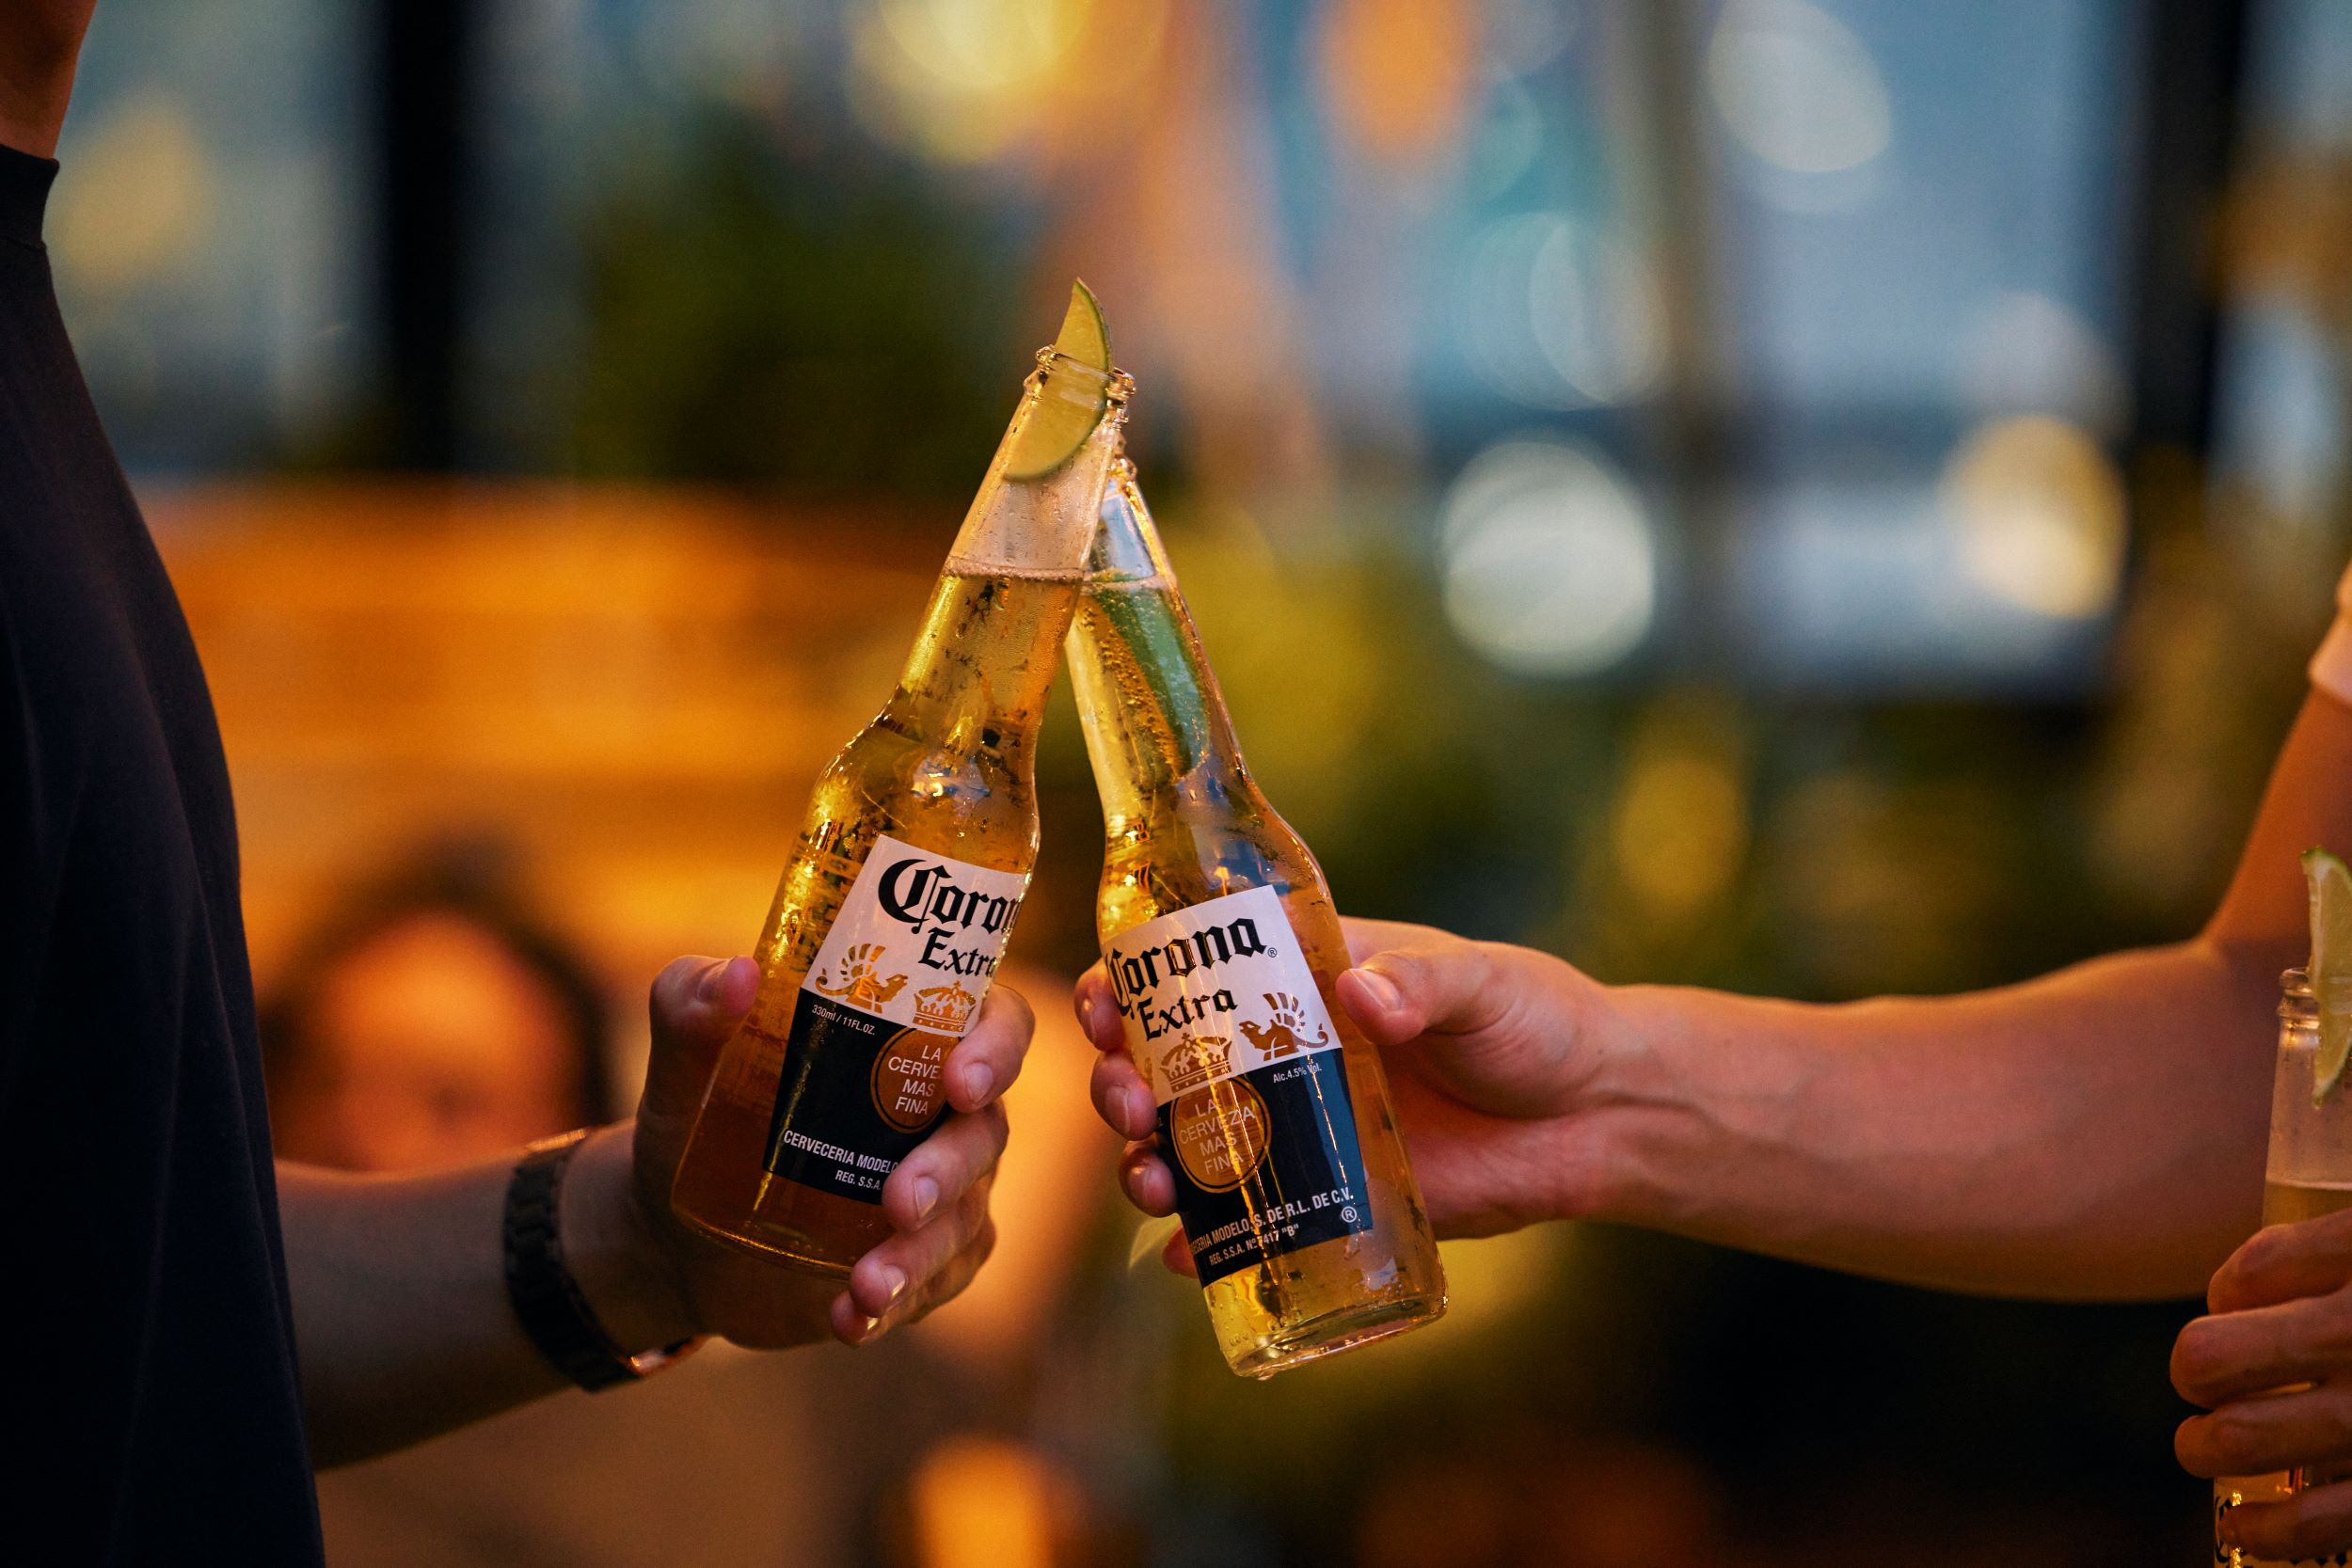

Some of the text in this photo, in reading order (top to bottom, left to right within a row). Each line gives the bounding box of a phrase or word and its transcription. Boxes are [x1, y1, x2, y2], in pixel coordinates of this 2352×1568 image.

[878, 859, 1023, 934] Coron
[812, 1005, 836, 1021] 330ml
[1137, 989, 1238, 1041] Extra
[922, 1045, 941, 1061] LA
[888, 1056, 942, 1079] CERVE
[902, 1079, 935, 1097] MAS
[895, 1096, 929, 1115] FINA
[1195, 1099, 1219, 1118] LA
[1179, 1106, 1256, 1144] CERVEZA
[784, 1130, 855, 1165] CERVECERIA
[1199, 1132, 1237, 1156] MAS
[1204, 1151, 1244, 1175] FINA
[835, 1170, 856, 1185] REG.
[1254, 1213, 1266, 1227] S.
[1266, 1206, 1285, 1223] DE
[1285, 1200, 1311, 1217] R.L.
[1311, 1193, 1330, 1209] DE
[1331, 1186, 1354, 1204] C.V.
[1209, 1252, 1224, 1266] REG.
[1223, 1242, 1245, 1259] S.S.A.
